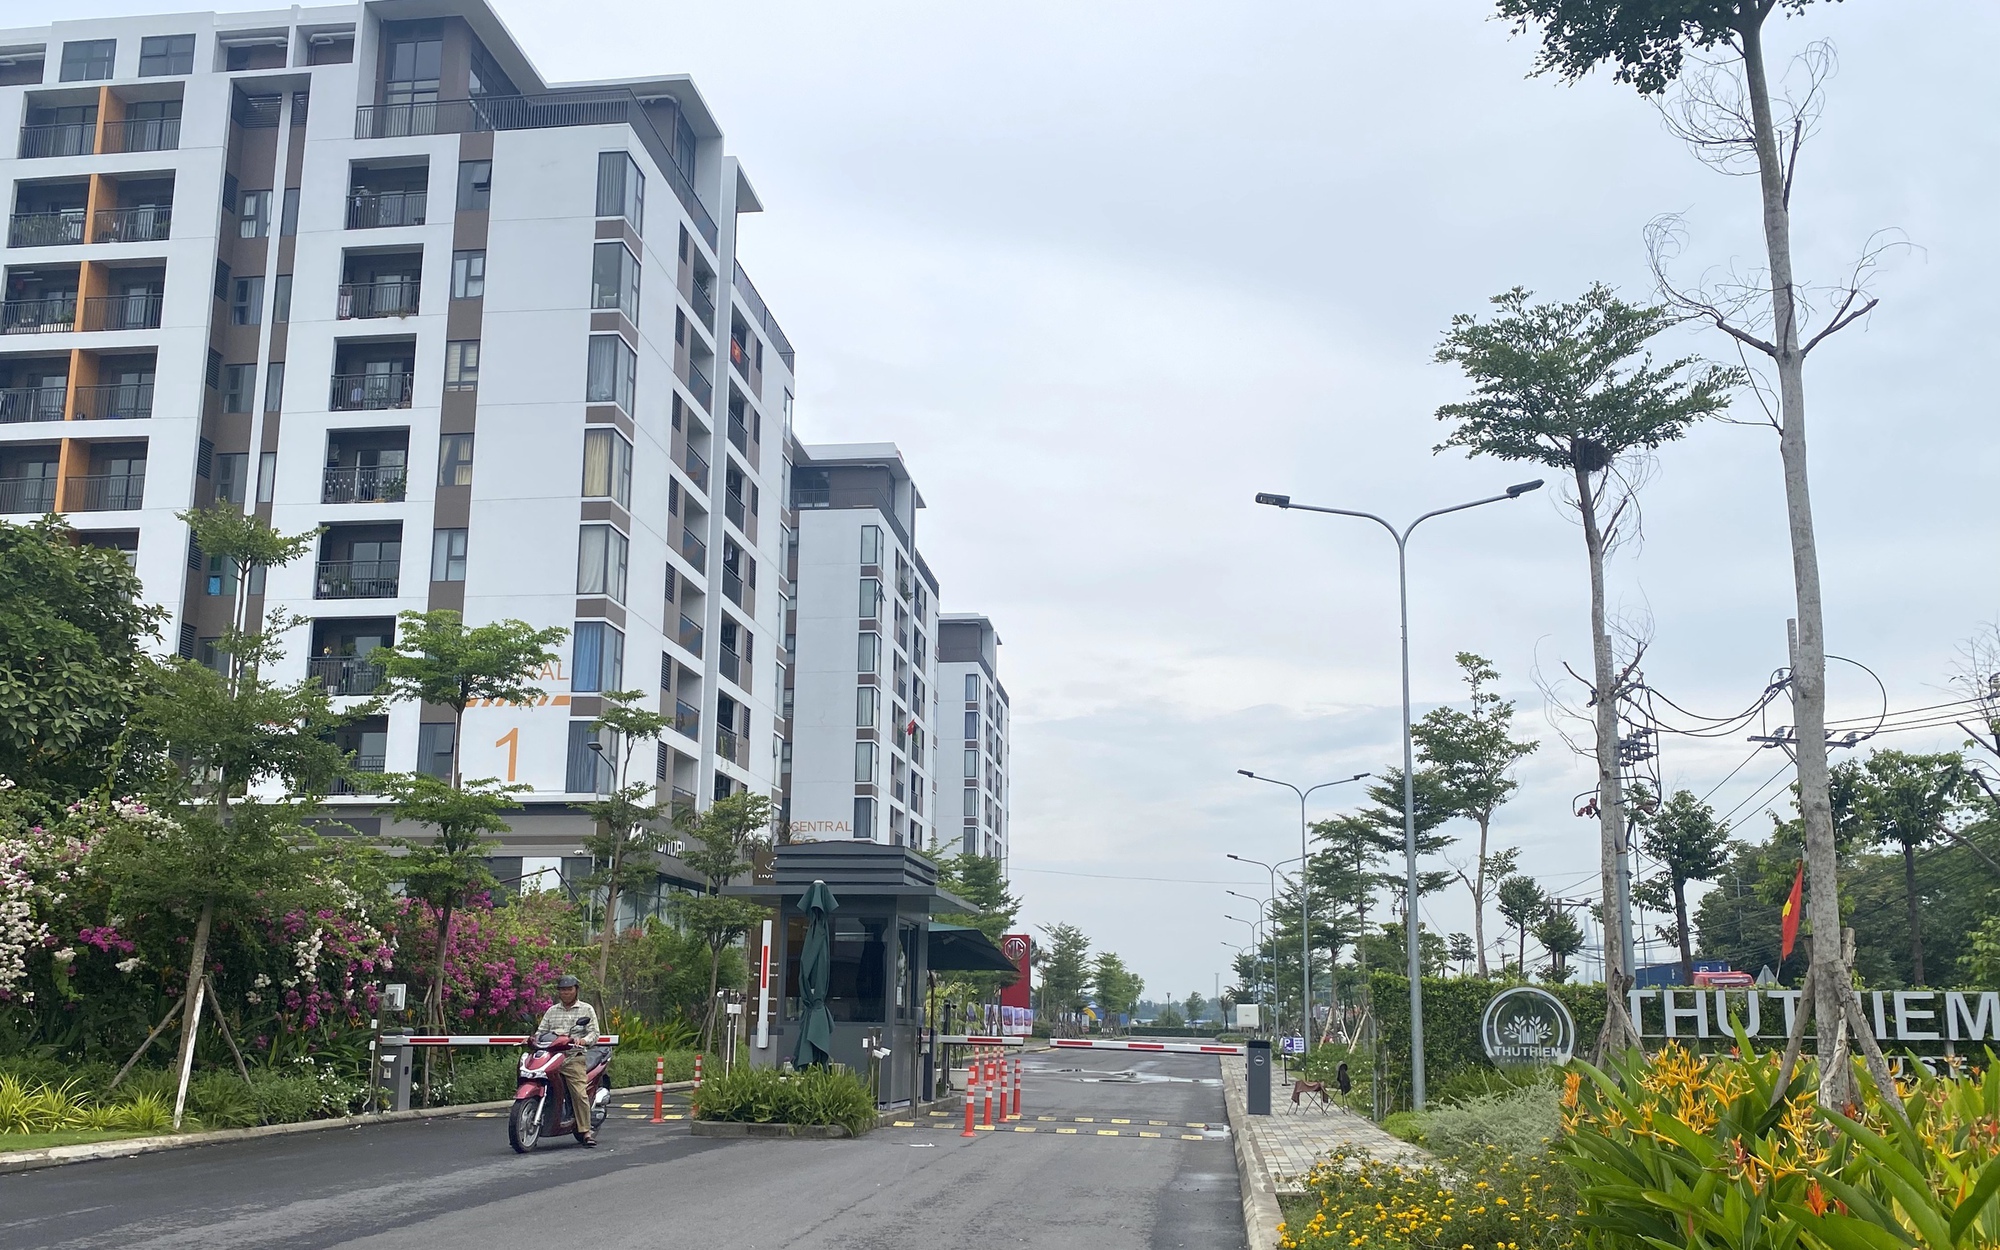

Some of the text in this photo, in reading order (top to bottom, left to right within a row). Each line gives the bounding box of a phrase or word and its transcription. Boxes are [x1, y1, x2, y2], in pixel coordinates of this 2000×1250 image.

[496, 728, 518, 782] 1
[791, 820, 853, 832] CENTRAL
[1627, 990, 2000, 1041] THUTIEM
